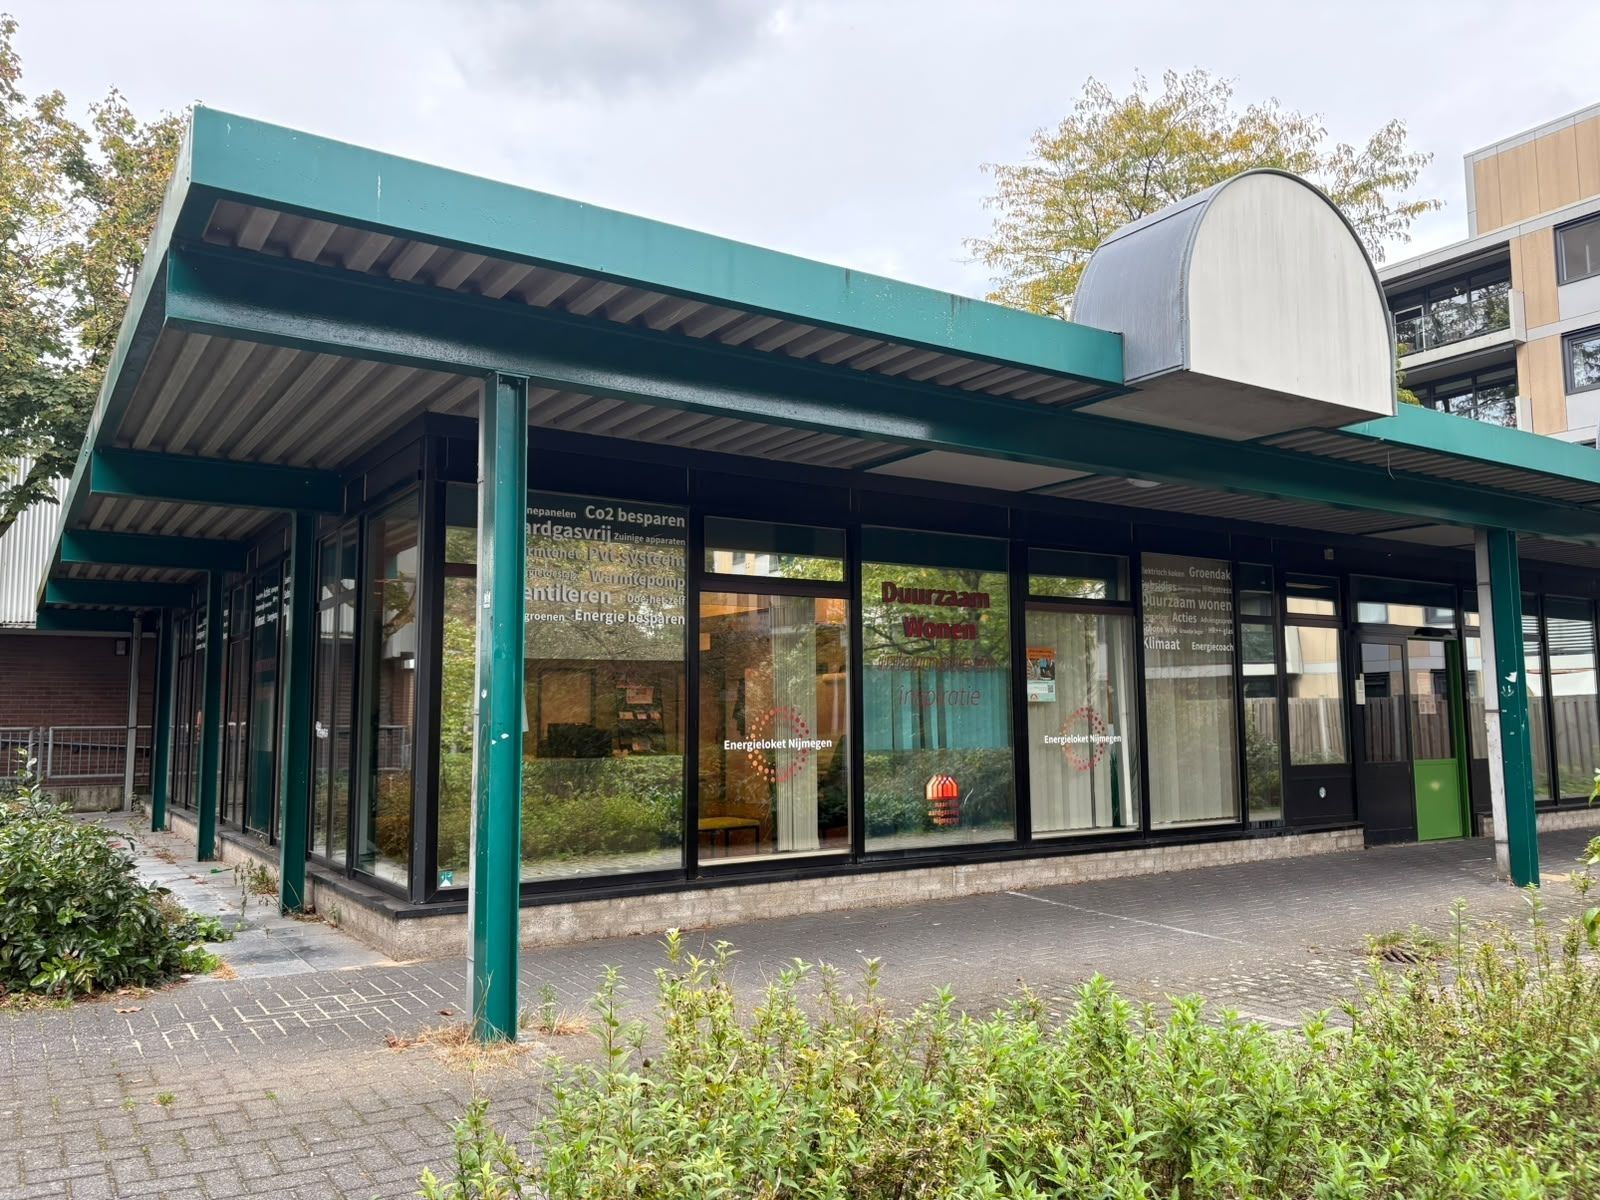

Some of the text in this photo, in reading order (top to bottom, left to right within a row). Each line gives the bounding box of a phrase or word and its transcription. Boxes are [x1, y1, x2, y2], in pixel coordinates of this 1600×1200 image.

[585, 505, 686, 528] Co2 besparen
[524, 520, 612, 543] ardgasvrij
[614, 532, 686, 547] Zuinige apparaten
[620, 550, 686, 567] systeem
[591, 569, 686, 593] Warmtepomp
[1188, 566, 1232, 581] Groendak
[881, 581, 991, 609] Duurzaam
[1142, 592, 1232, 611] Duurzaam wonen
[575, 608, 686, 626] Energie besparen
[1172, 611, 1197, 624] Acties
[902, 614, 978, 641] Wonen
[1143, 636, 1181, 651] Klimaat
[1191, 641, 1234, 653] Energiecoach
[898, 683, 982, 707] inpratie
[724, 738, 833, 752] Energieloket Nijmegen
[1044, 735, 1122, 746] Energieloket Nijmegen
